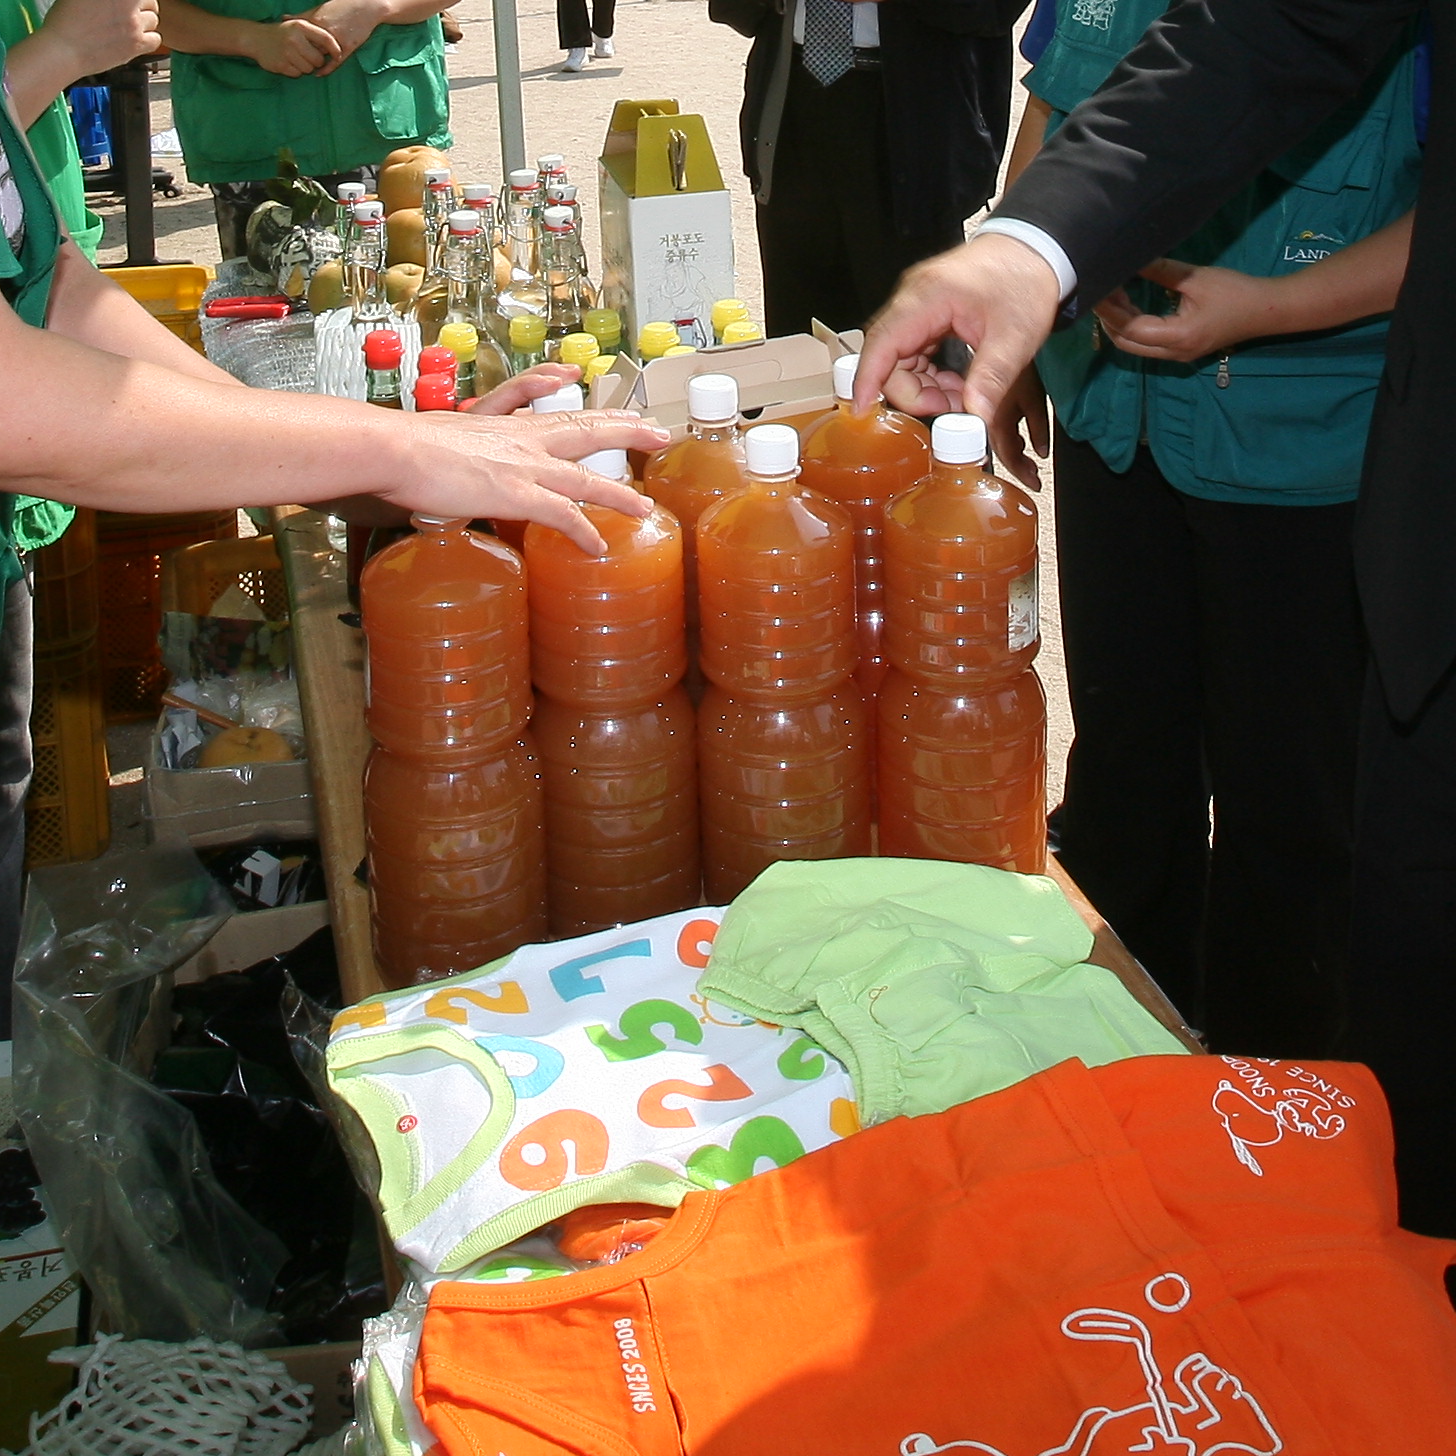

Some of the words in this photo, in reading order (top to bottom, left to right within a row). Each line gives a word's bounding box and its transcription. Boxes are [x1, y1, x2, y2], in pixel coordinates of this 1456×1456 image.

[659, 232, 706, 248] 거봉포도
[664, 248, 700, 263] 증류수
[1286, 1066, 1356, 1108] SINCE
[613, 1317, 641, 1360] 2008
[621, 1362, 657, 1414] SNCES
